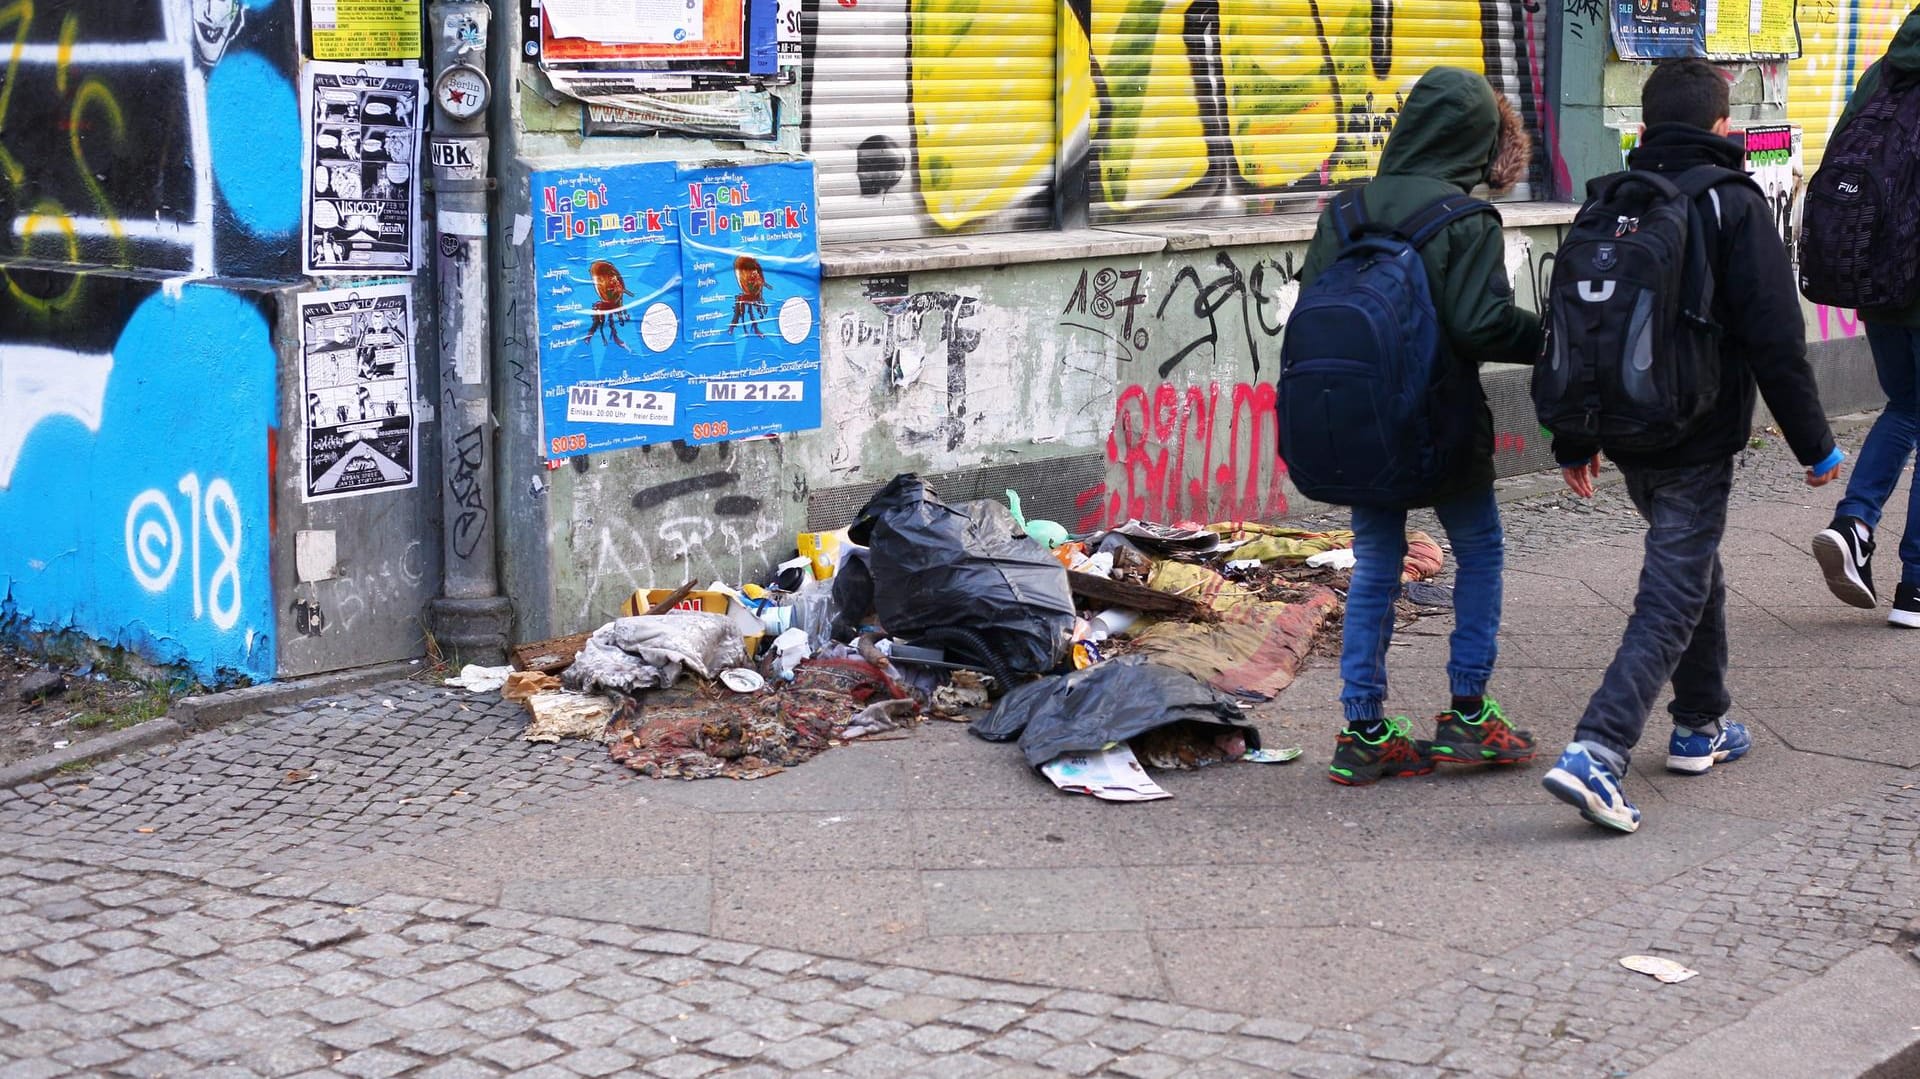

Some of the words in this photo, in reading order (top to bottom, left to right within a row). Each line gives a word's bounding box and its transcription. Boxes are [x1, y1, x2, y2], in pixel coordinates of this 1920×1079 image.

[450, 78, 480, 93] Berlin
[465, 93, 478, 107] U
[431, 143, 471, 166] WBK
[1750, 149, 1790, 168] MOPED
[689, 181, 750, 210] Nacht
[1838, 182, 1859, 193] FILA
[544, 184, 608, 214] Nacht
[546, 204, 672, 242] Flohmarkt
[690, 202, 808, 237] Flohmarkt
[571, 388, 598, 406] Mi
[606, 390, 663, 410] 21.2.
[711, 384, 736, 400] Mi
[744, 384, 797, 400] 21.2.
[596, 409, 613, 418] 20:00
[615, 410, 626, 419] Uhr
[650, 413, 669, 421] Eintritt
